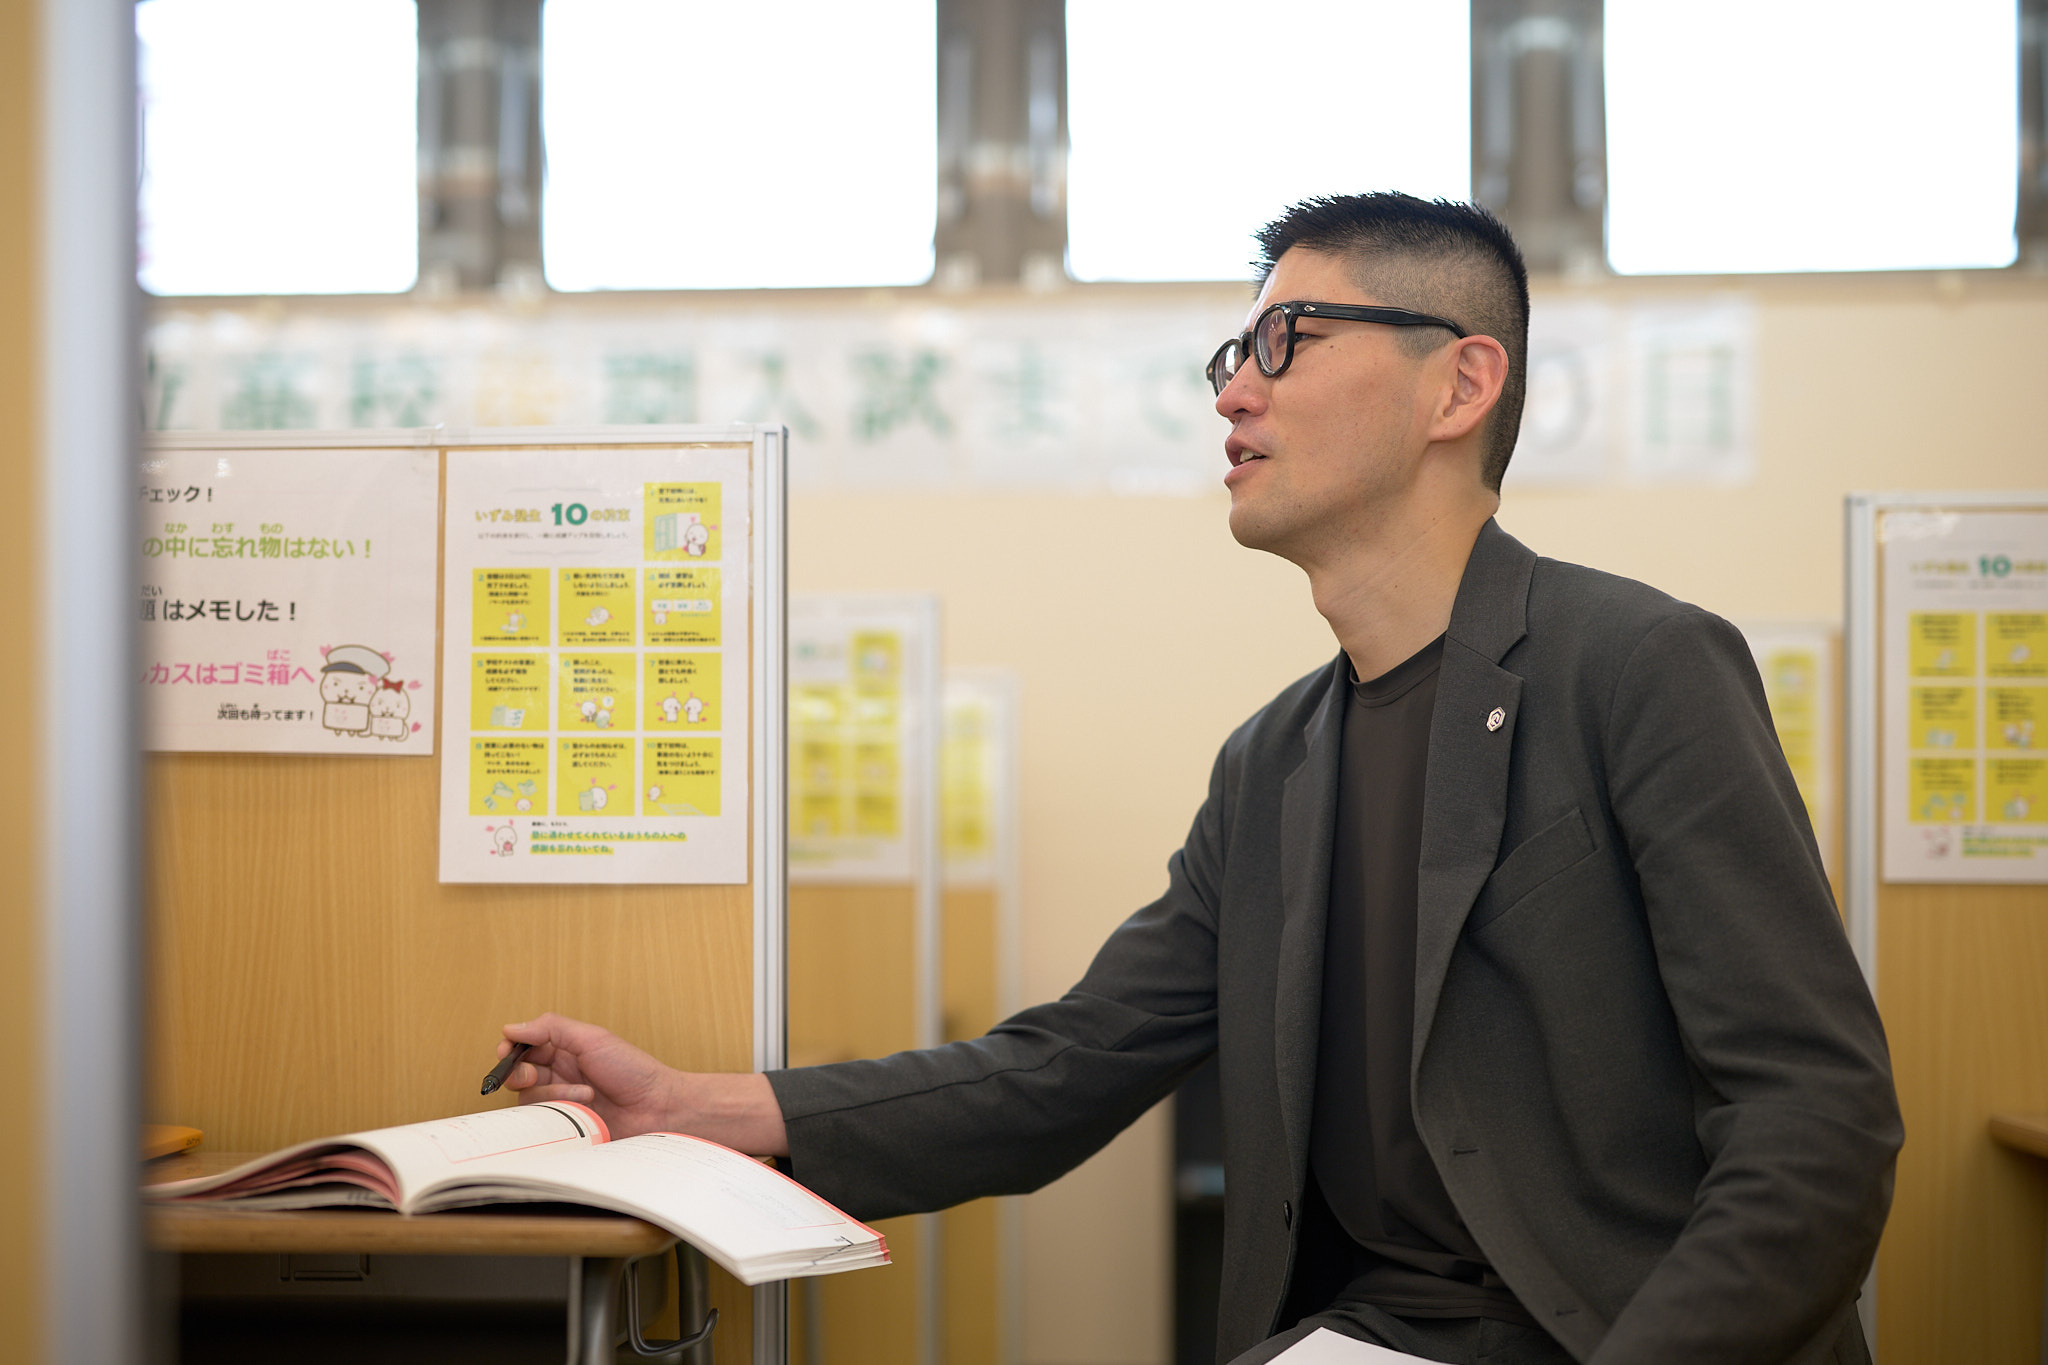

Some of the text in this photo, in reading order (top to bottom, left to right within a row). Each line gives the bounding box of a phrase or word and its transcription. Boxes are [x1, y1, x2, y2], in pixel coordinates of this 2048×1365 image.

[165, 523, 283, 534] なか わす もの
[143, 536, 371, 559] の中に忘れ物はない！
[140, 663, 315, 686] カスはゴミ箱へ
[217, 709, 315, 722] 次回も待ってます！
